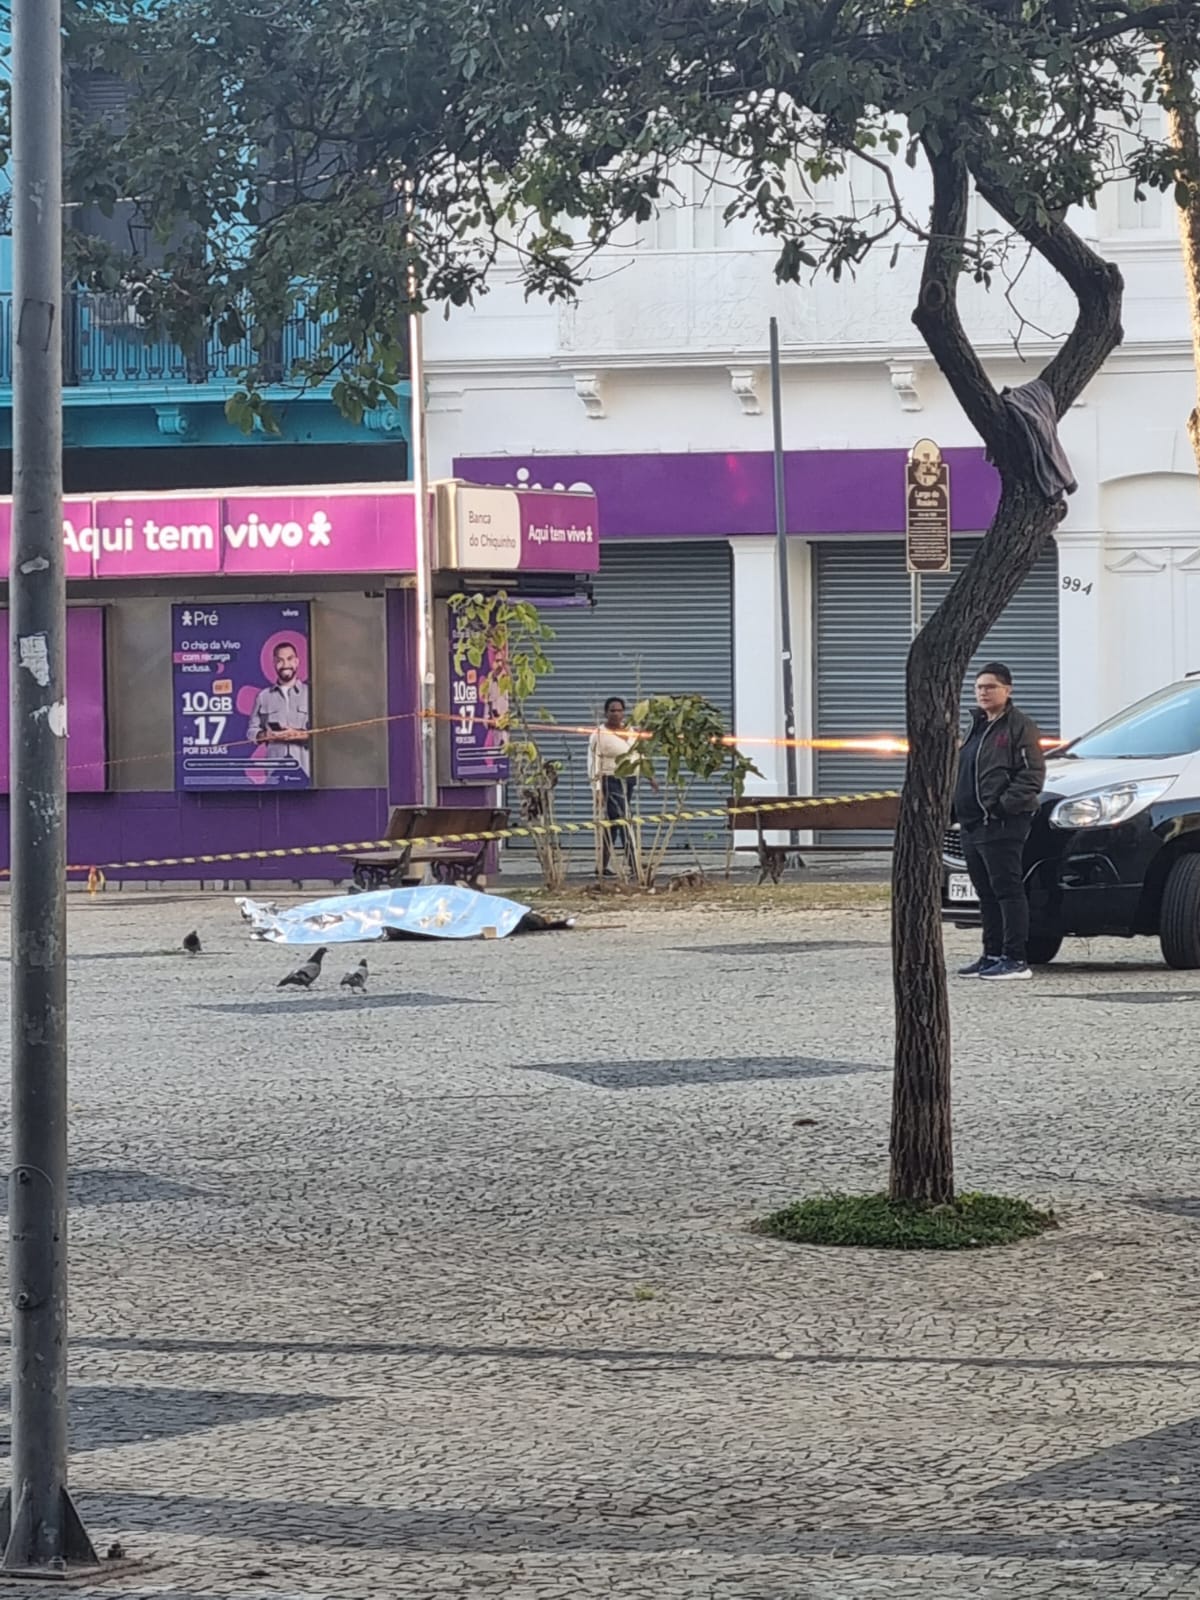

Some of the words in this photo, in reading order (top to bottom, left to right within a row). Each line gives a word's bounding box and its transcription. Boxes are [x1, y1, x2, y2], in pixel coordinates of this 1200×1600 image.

[468, 511, 492, 525] Banca
[62, 518, 134, 560] Aqui
[143, 519, 213, 550] tem
[224, 513, 304, 548] vivo
[469, 535, 480, 547] do
[480, 533, 517, 550] Chiquinho
[528, 524, 549, 545] Aqui
[550, 526, 566, 542] tem
[567, 525, 586, 543] vivo
[1062, 576, 1093, 596] 994
[194, 610, 219, 626] Pré
[181, 641, 189, 650] O
[190, 641, 208, 652] chip
[209, 641, 220, 650] da
[221, 640, 241, 650] Vivo
[201, 653, 231, 662] recarga
[182, 691, 233, 712] 10GB
[453, 681, 477, 702] 10GB
[193, 716, 227, 745] 17
